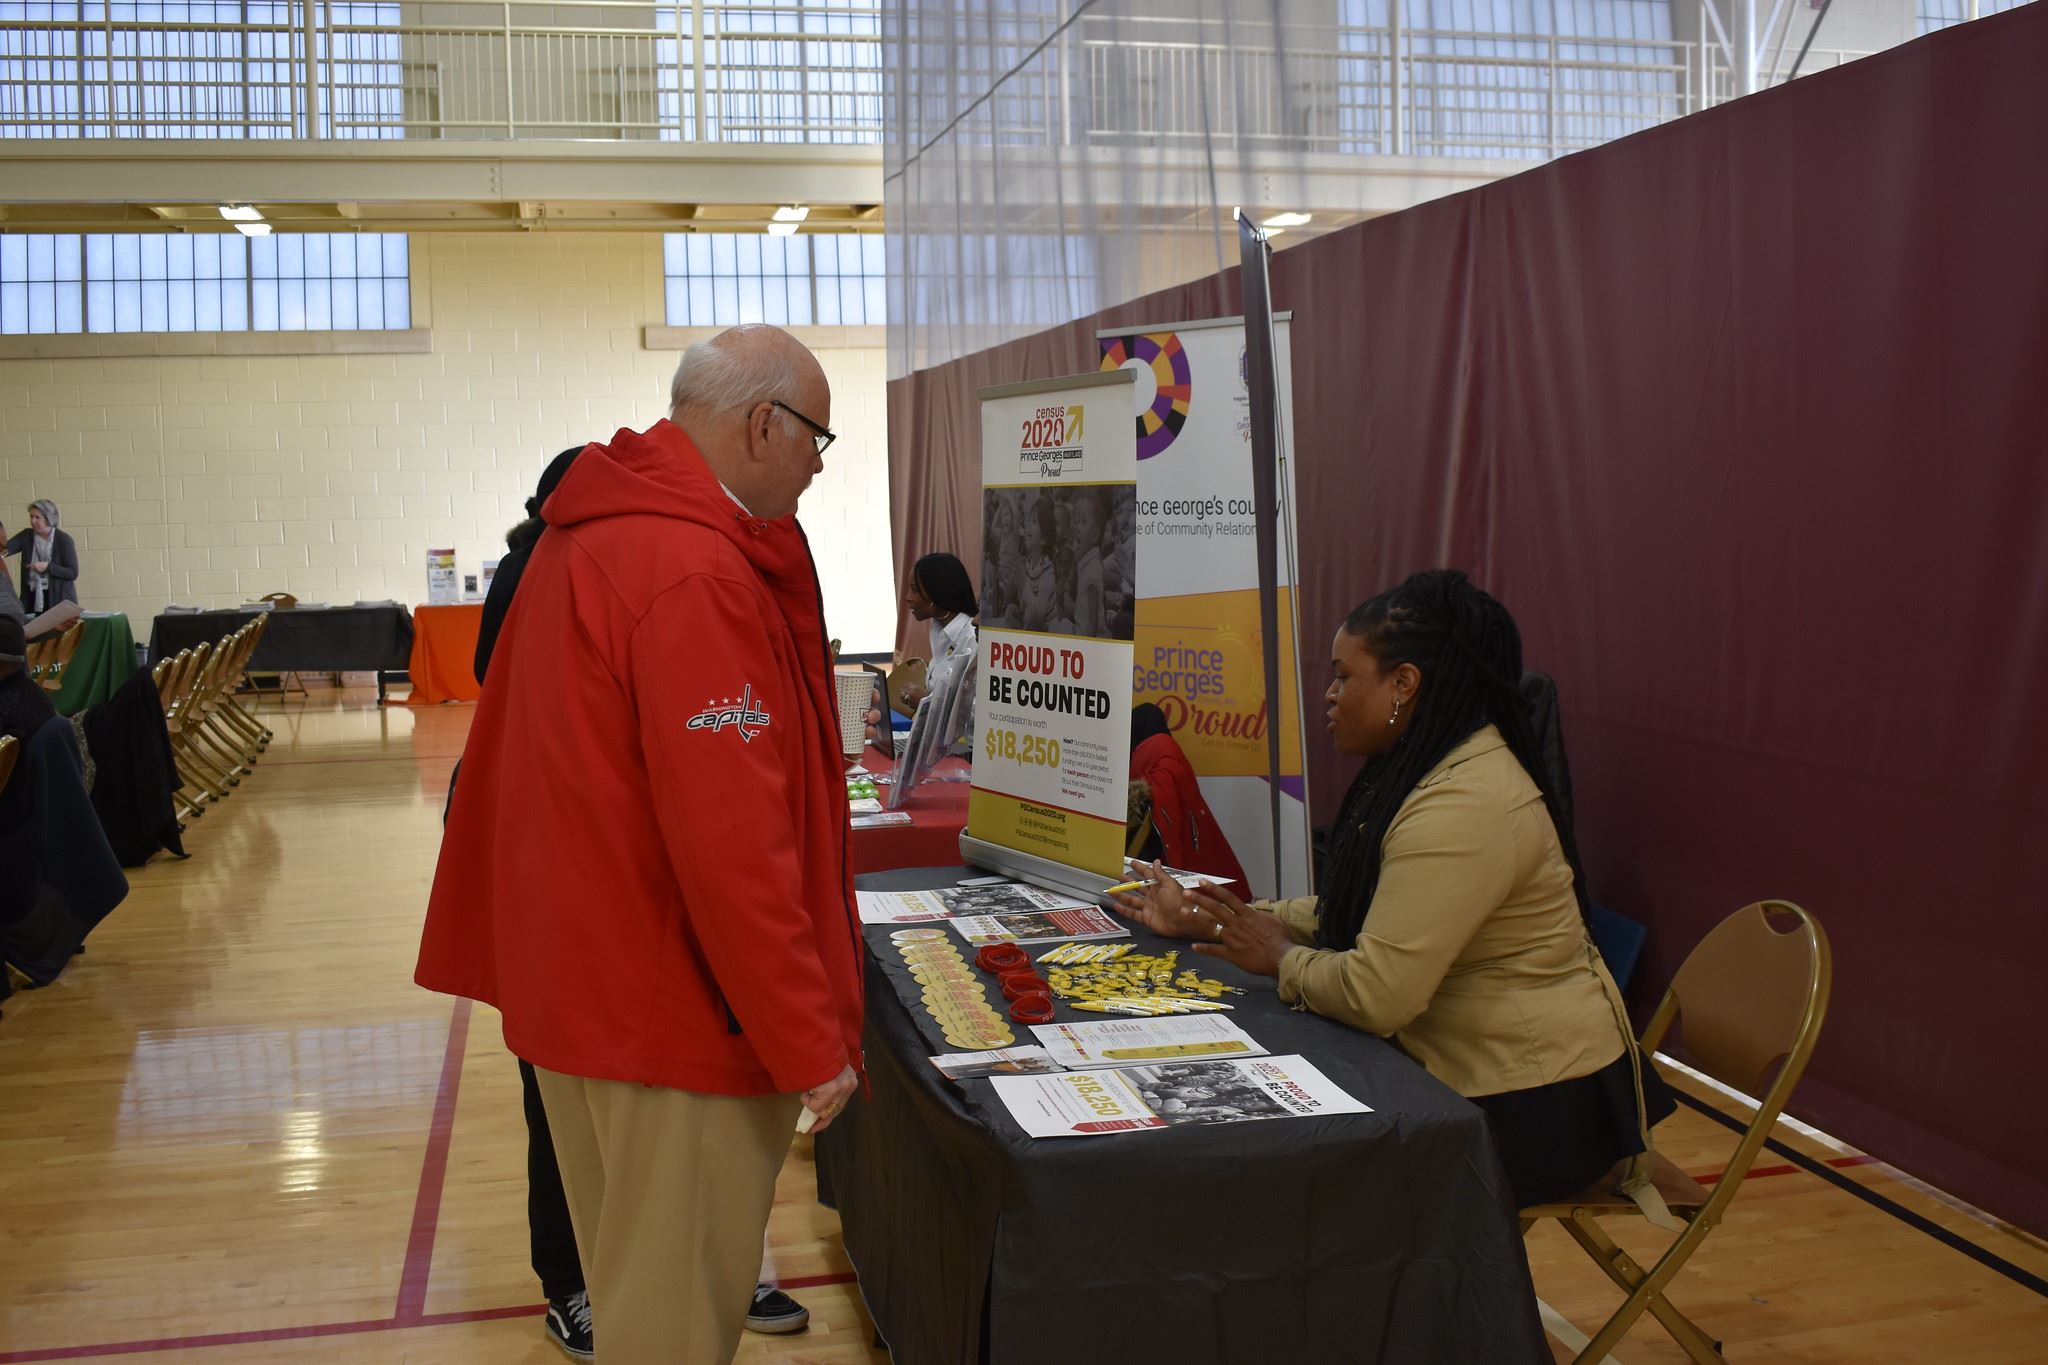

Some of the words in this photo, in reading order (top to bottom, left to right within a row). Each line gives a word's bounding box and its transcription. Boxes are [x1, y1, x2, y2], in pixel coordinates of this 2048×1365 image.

[1036, 406, 1065, 419] census
[1021, 418, 1065, 449] 2020
[1136, 500, 1158, 515] nce
[1163, 495, 1224, 520] George's
[1145, 522, 1155, 535] of
[1157, 521, 1214, 539] Community
[1216, 522, 1257, 536] Relation
[990, 641, 1055, 675] PROUD
[1060, 649, 1084, 680] TO
[1154, 640, 1224, 672] Prince
[686, 683, 770, 743] capitals
[989, 675, 1012, 704] BE
[1016, 679, 1111, 720] COUNTED
[1155, 695, 1268, 741] Proud
[986, 727, 1061, 769] $18,250
[1065, 1075, 1124, 1116] $18,250
[1281, 1081, 1312, 1100] PROUD
